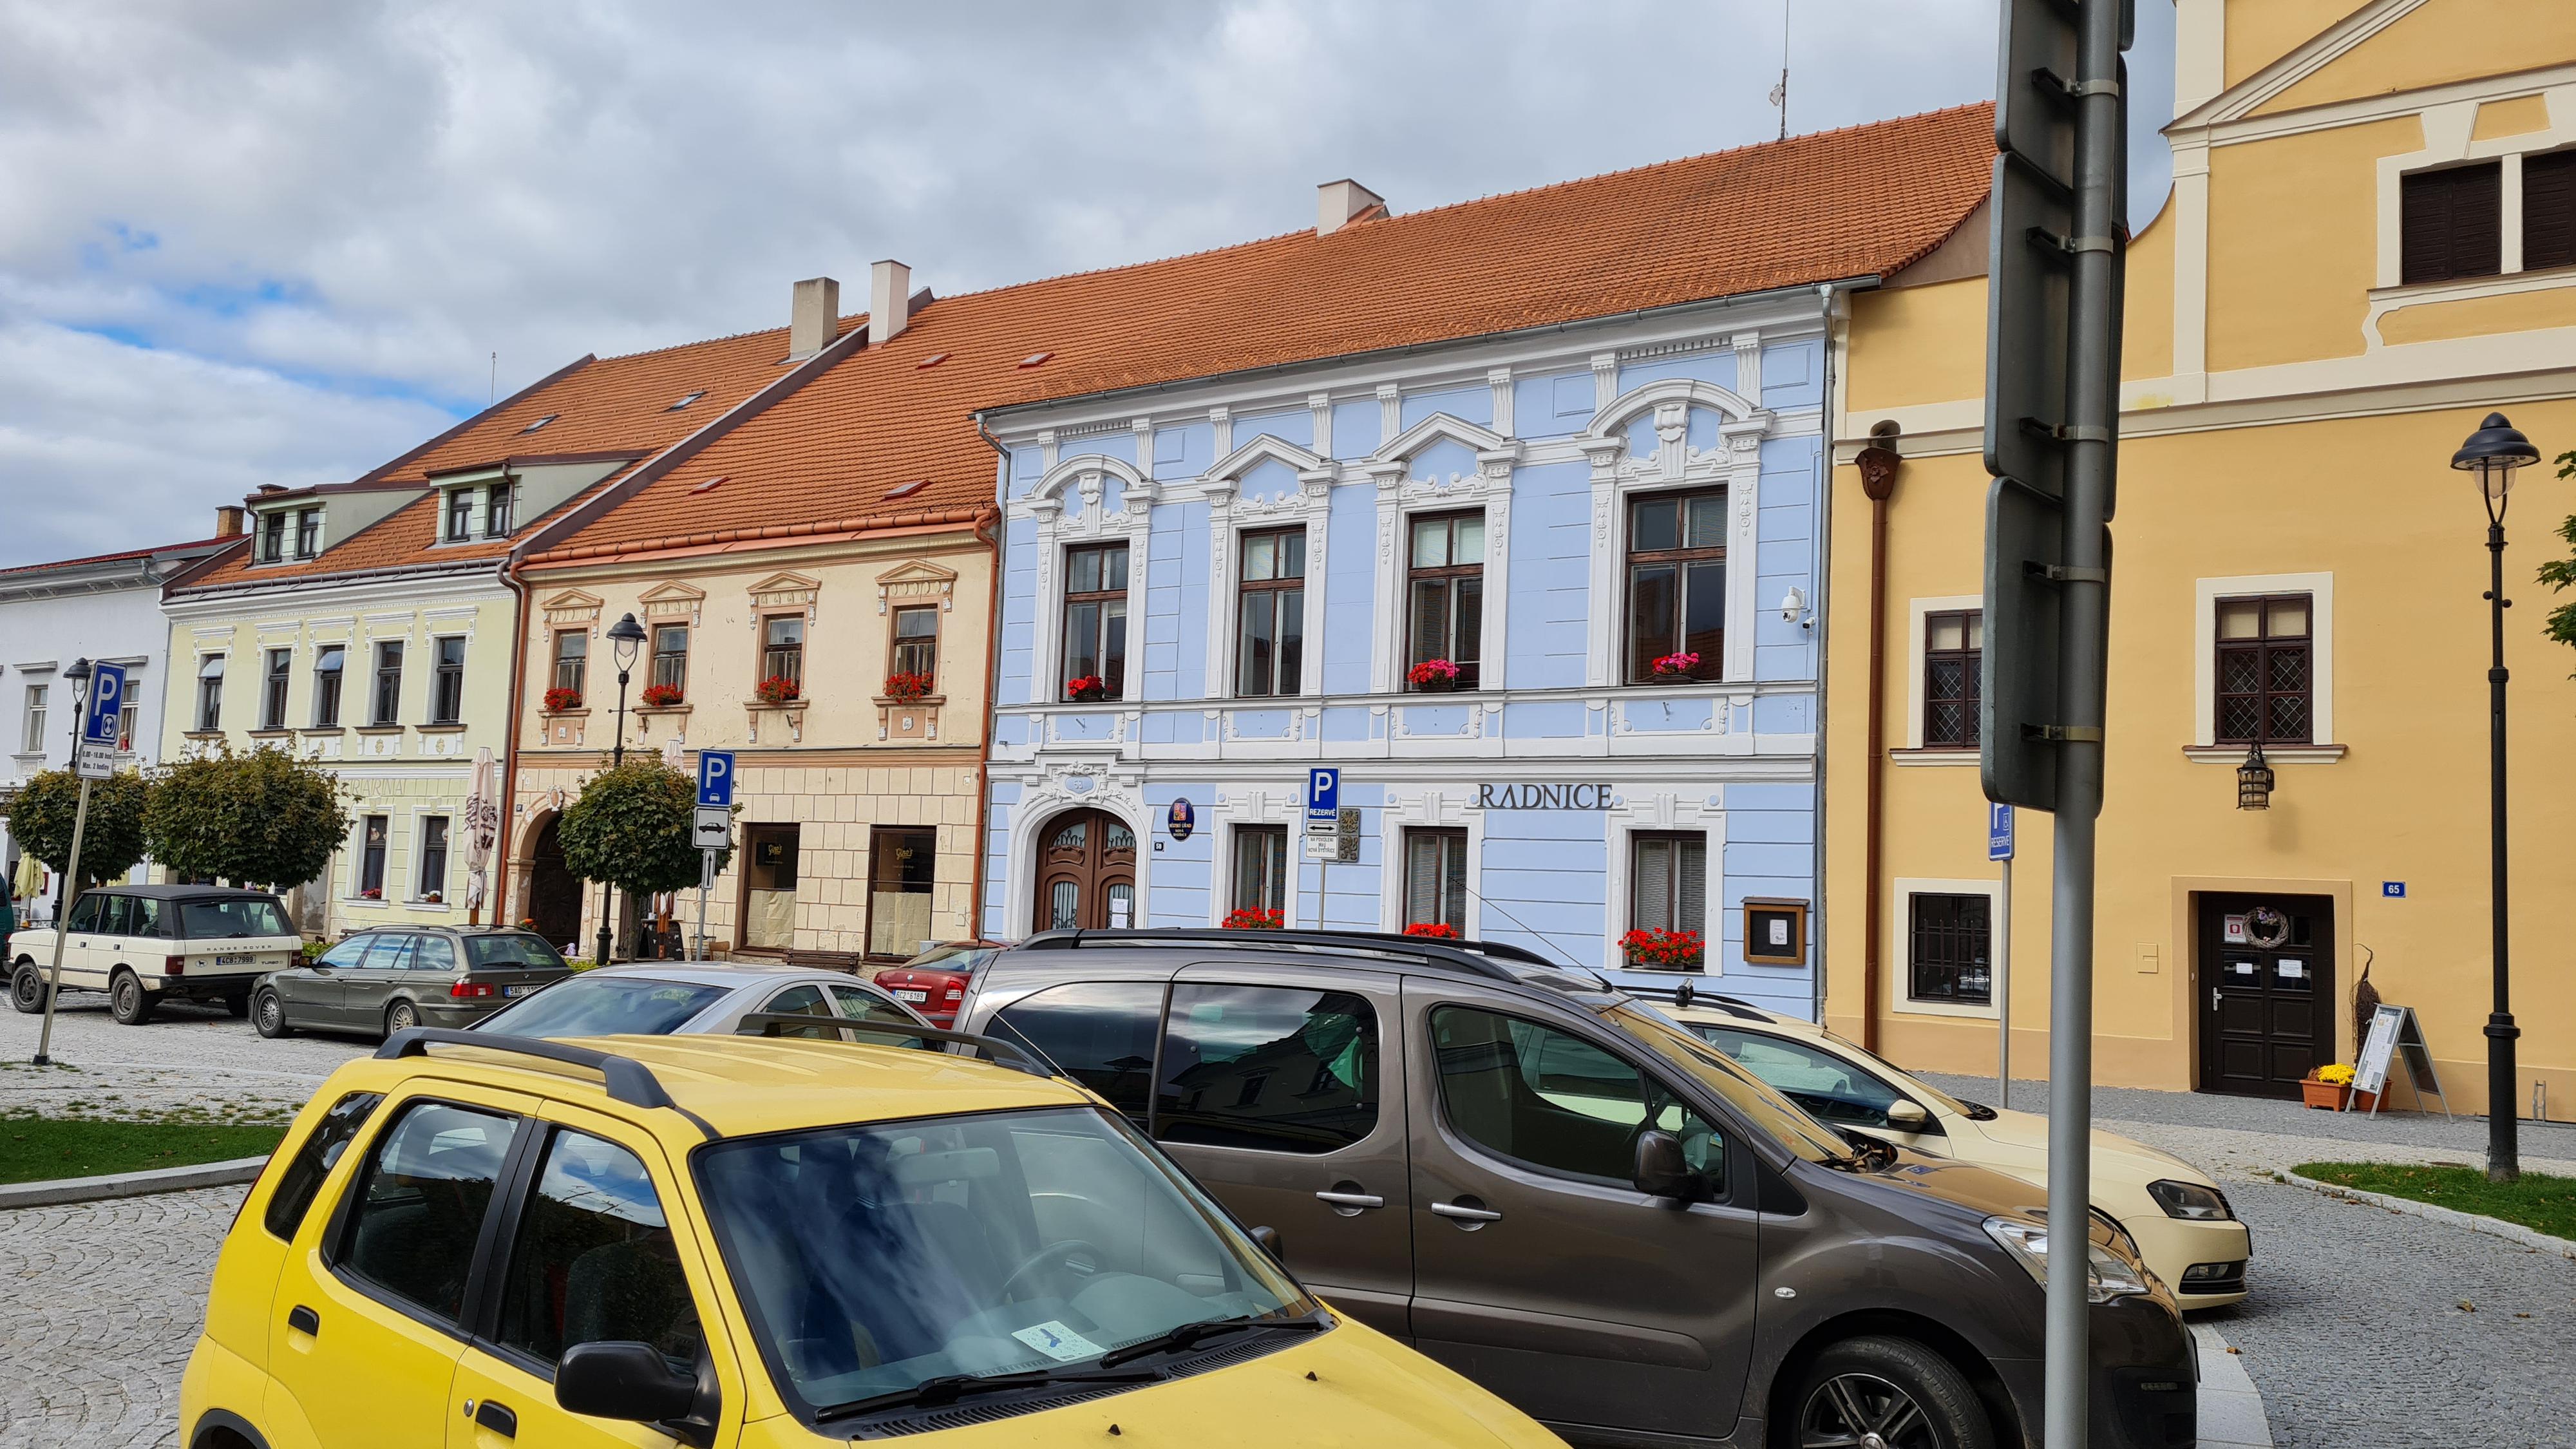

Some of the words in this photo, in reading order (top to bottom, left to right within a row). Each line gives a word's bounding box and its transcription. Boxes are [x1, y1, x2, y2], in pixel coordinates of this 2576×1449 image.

[95, 673, 117, 716] P
[706, 757, 726, 788] P
[1314, 772, 1332, 801] P
[1477, 783, 1614, 810] RADNICE
[1309, 808, 1336, 816] REZERVÉ
[2388, 885, 2400, 894] 65
